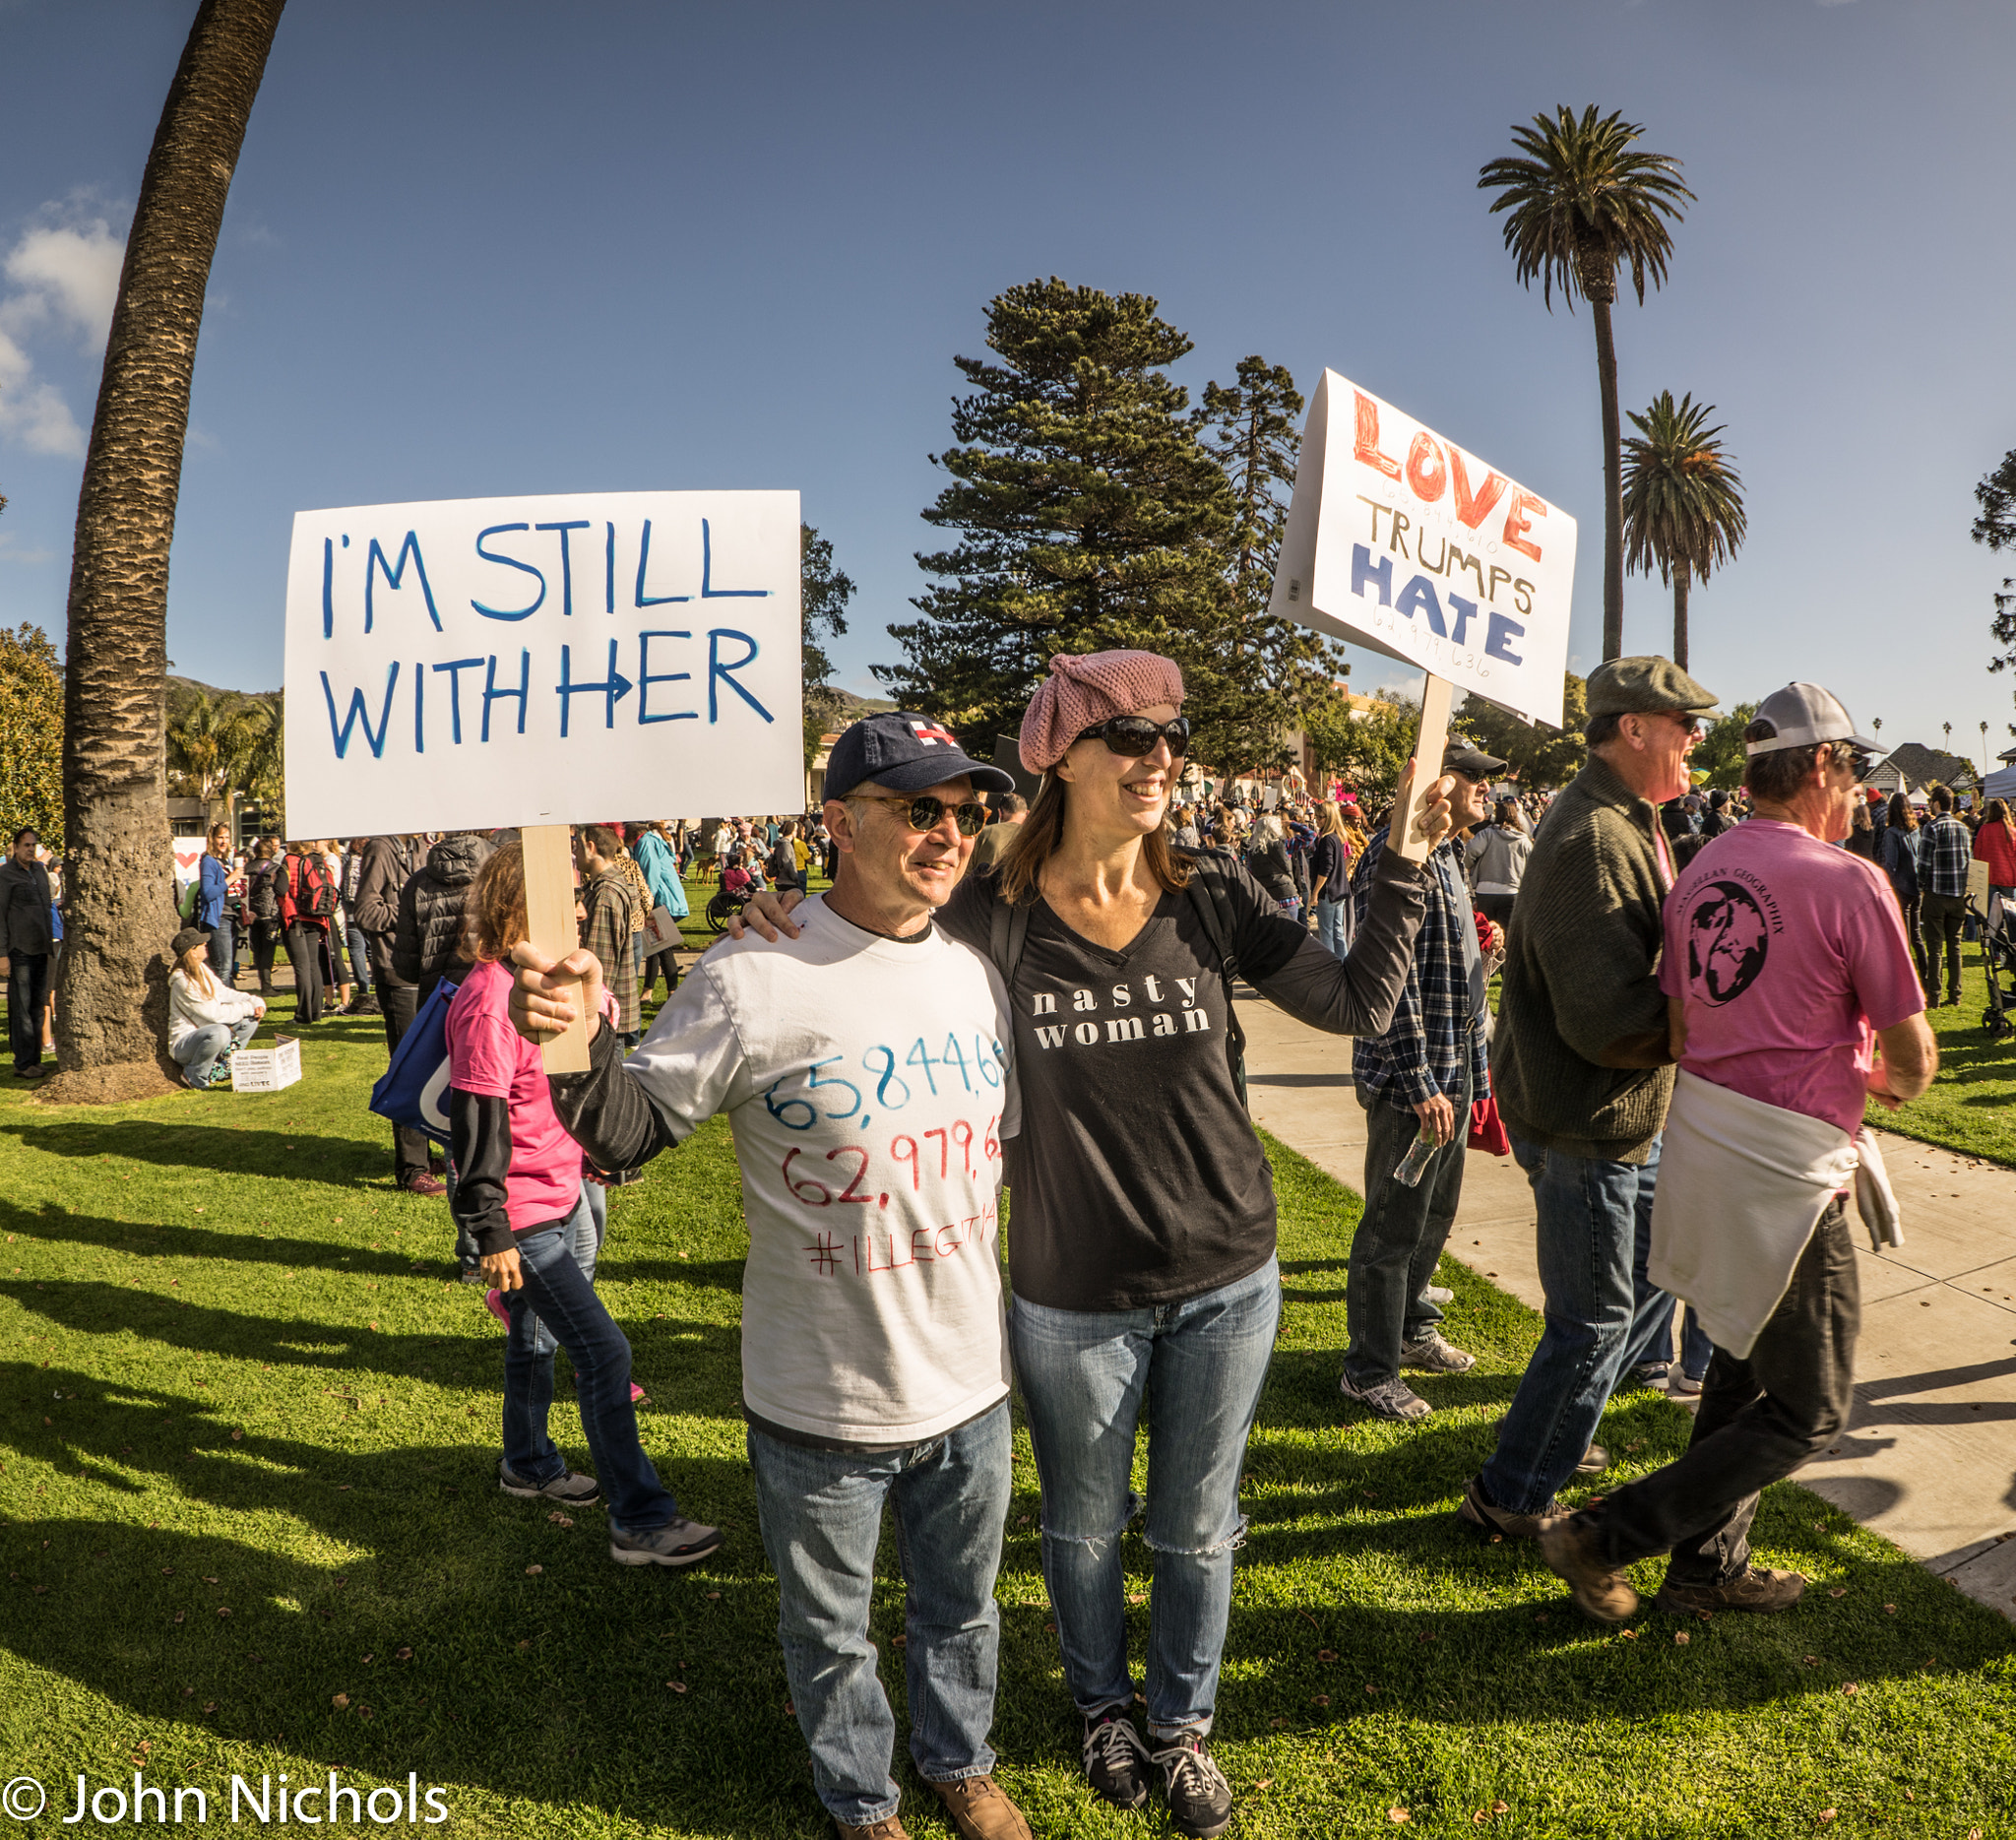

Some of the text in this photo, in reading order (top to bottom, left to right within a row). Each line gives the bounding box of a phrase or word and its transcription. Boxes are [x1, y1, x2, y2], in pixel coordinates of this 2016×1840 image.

[1353, 387, 1547, 563] LOVE
[322, 517, 776, 640] I'M STILL
[1351, 541, 1526, 667] HATE
[1355, 493, 1537, 615] TRUMPS
[319, 627, 776, 760] WITH HER
[1733, 866, 1786, 935] GEOGRAPHIX
[1031, 973, 1199, 1018] nasty
[1033, 1002, 1211, 1050] woman
[782, 1113, 1002, 1211] 62,979,6
